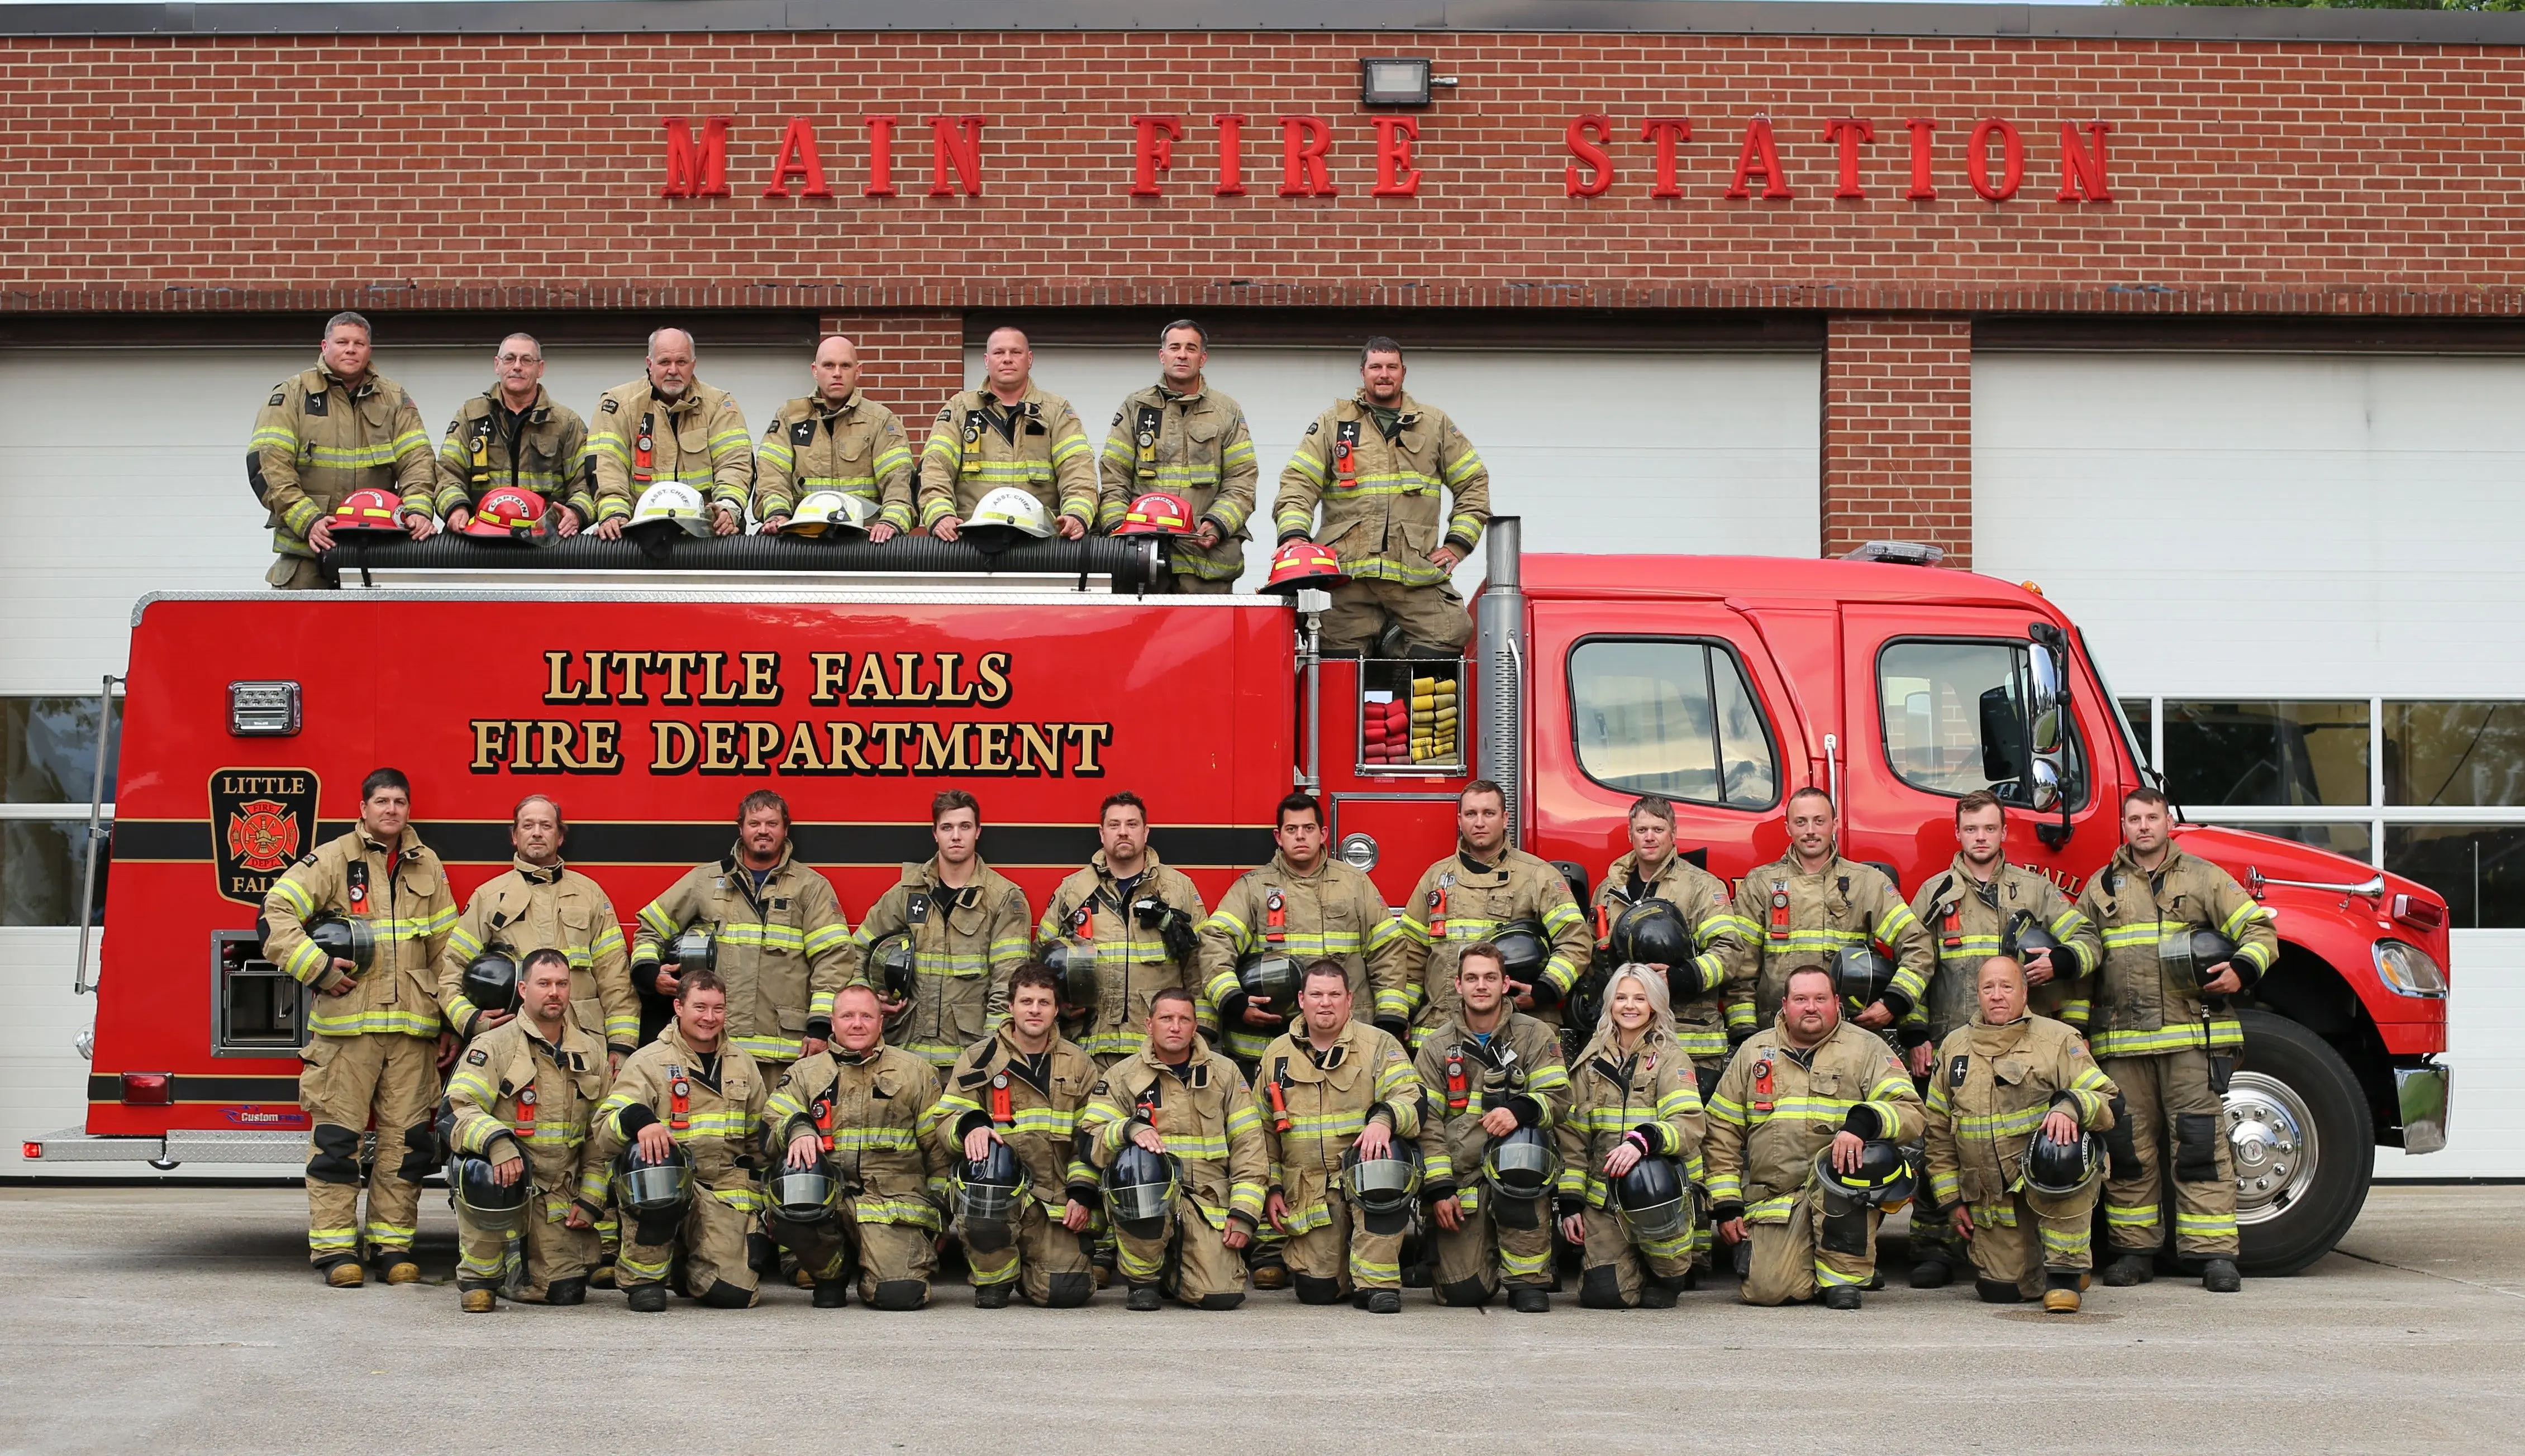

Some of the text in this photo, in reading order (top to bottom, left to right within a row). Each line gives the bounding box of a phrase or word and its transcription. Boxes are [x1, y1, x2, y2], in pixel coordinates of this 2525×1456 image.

[661, 113, 2113, 202] MAIN FIRE STATION
[490, 496, 527, 513] CAPTAIN
[670, 489, 689, 504] CHIEF
[1014, 495, 1031, 512] CHIEF
[1143, 497, 1174, 506] CAPTAIN
[544, 651, 1010, 705] LITTLE FALLS
[470, 720, 1110, 774] FIRE DEPARTMENT
[223, 777, 305, 794] LITTLE
[253, 804, 274, 813] FIRE
